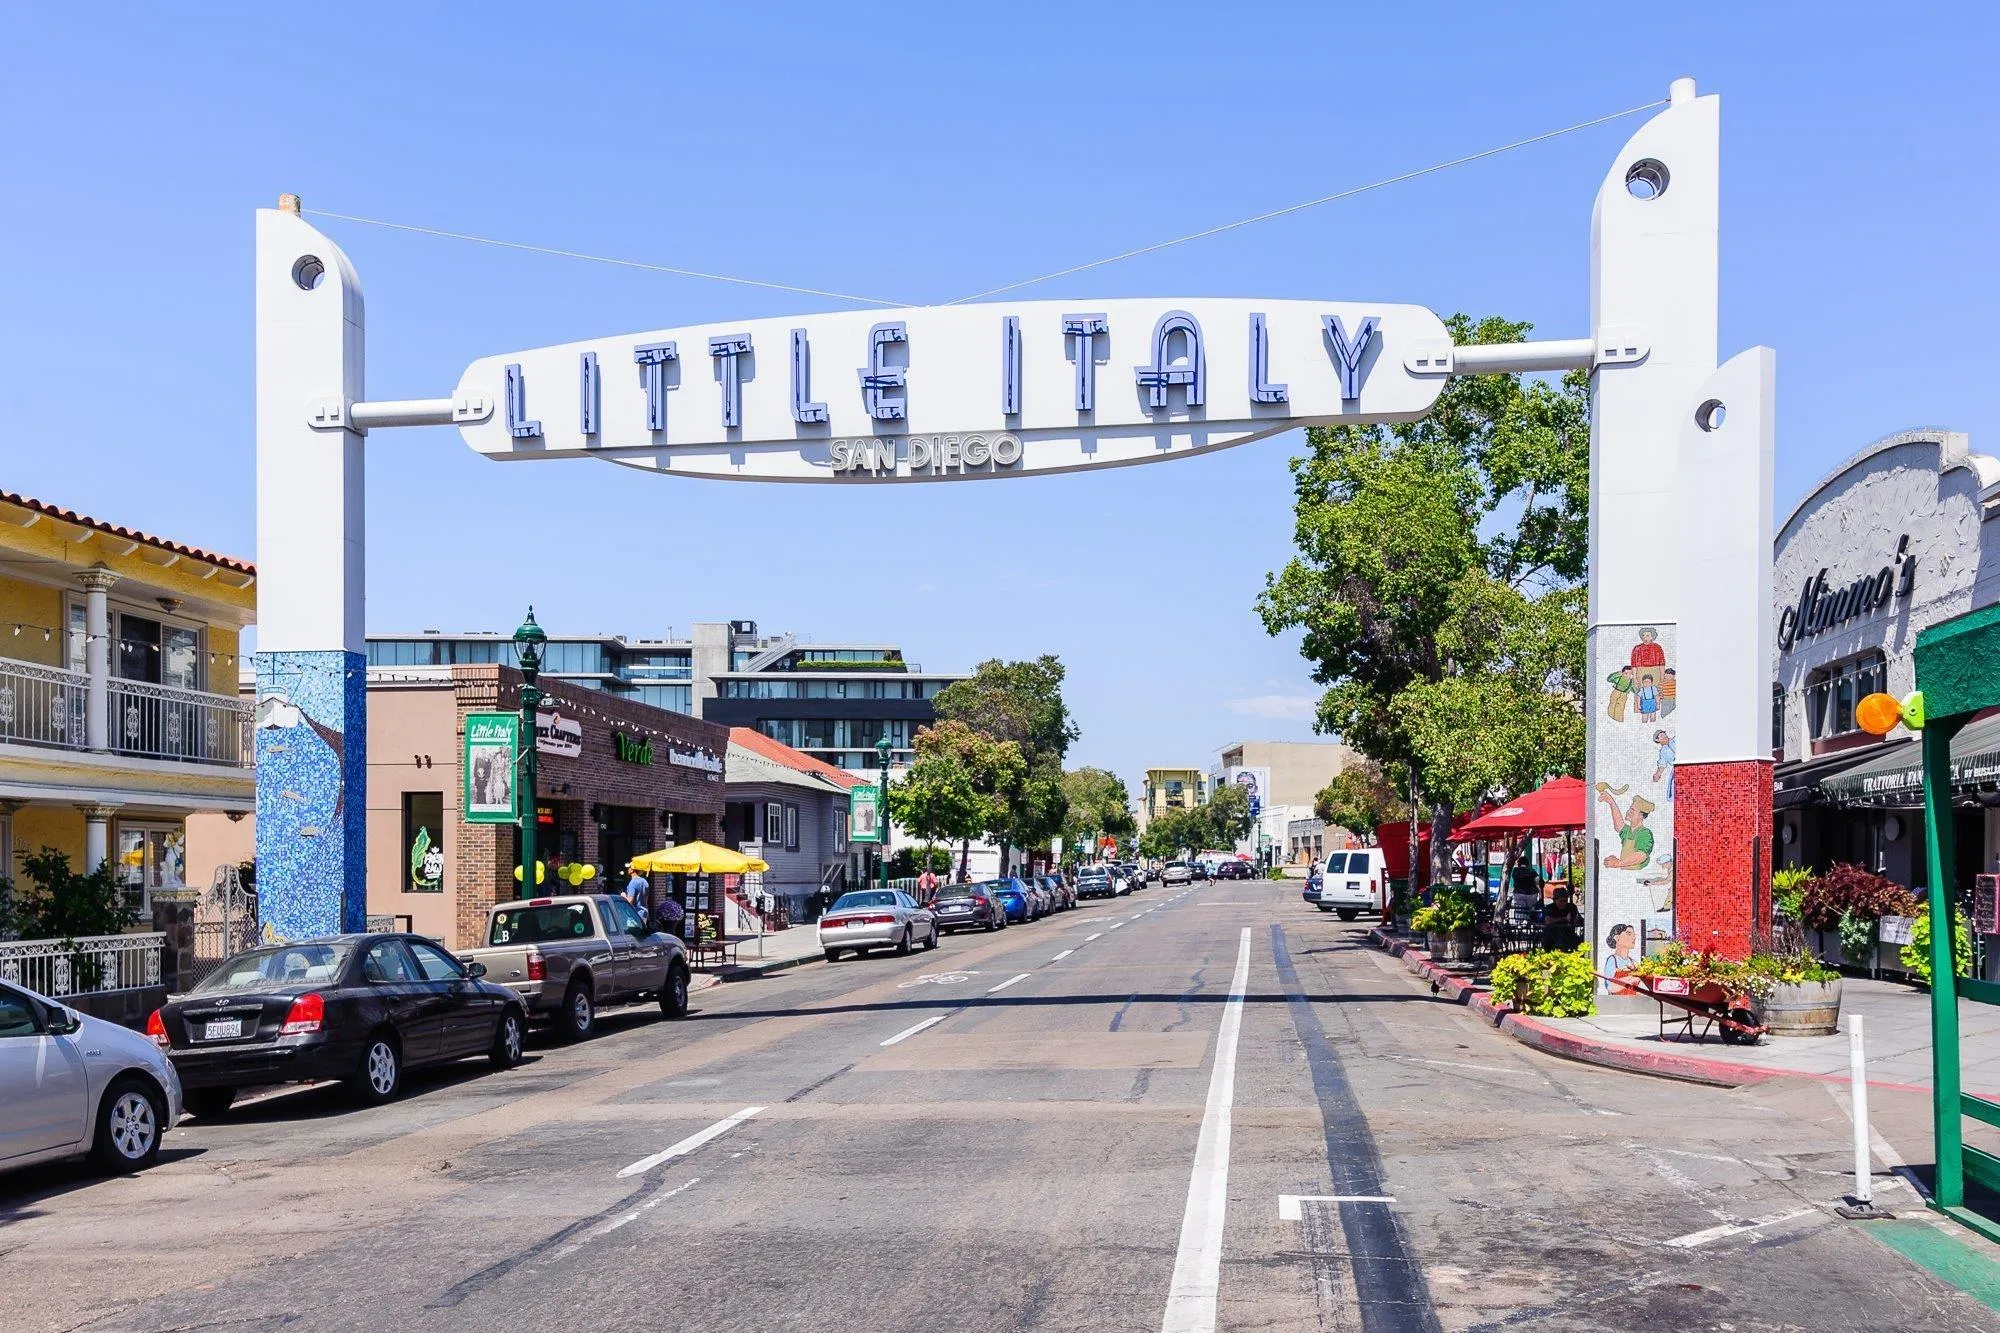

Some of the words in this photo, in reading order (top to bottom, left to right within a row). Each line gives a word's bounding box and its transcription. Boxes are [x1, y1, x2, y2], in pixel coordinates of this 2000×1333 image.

[504, 320, 907, 438] LITTLE
[1002, 309, 1382, 415] ITALY
[830, 438, 897, 472] SAN
[907, 433, 1022, 470] DIEGO
[1777, 533, 1916, 651] Mimmo's
[469, 719, 493, 738] Little
[494, 718, 513, 746] Italy
[617, 731, 654, 765] Verde
[1863, 773, 1905, 793] TRATTORIA
